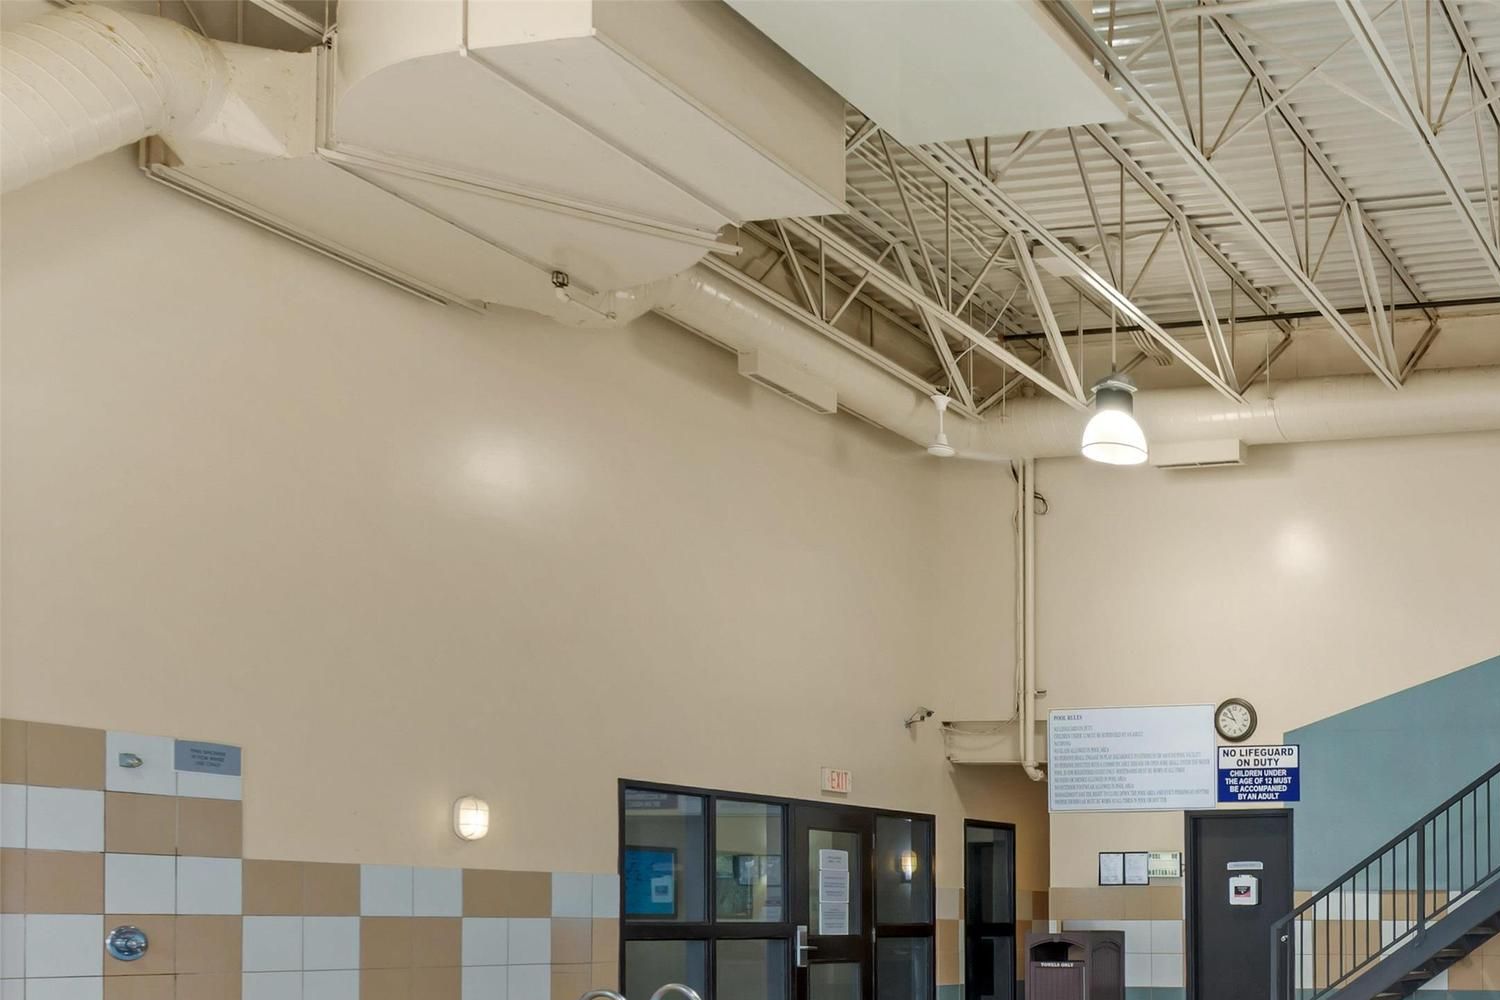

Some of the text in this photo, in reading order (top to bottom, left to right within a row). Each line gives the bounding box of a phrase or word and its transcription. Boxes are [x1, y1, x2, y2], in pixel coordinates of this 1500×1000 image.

[1222, 747, 1294, 757] NO LIFEGUARD
[1236, 758, 1280, 767] ON DUTY
[831, 770, 848, 790] EXIT
[1239, 777, 1253, 785] AGE
[1273, 776, 1292, 784] MUST
[1229, 784, 1288, 793] BE ACCOMPANIED
[1247, 792, 1257, 800] AN
